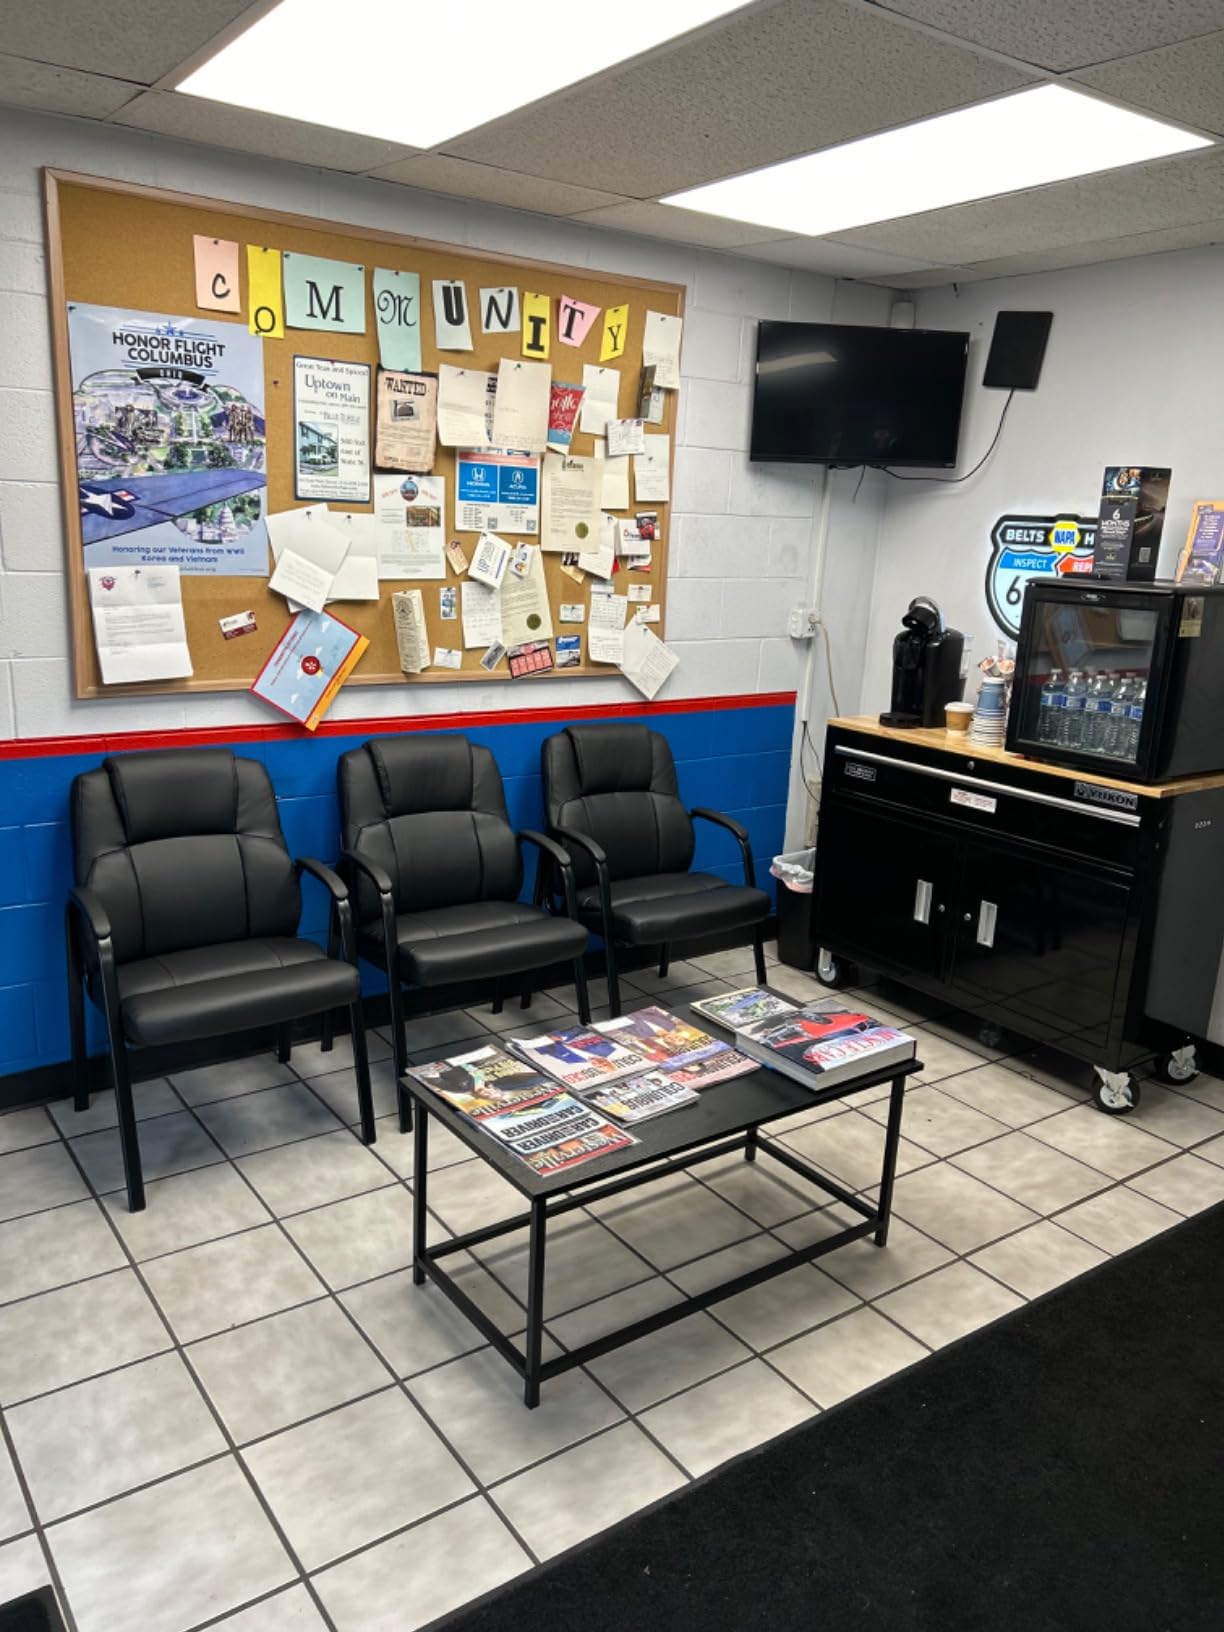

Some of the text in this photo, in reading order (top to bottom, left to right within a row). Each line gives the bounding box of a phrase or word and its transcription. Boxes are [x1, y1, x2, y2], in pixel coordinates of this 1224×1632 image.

[112, 331, 226, 357] HONOR FLIGHT
[128, 348, 213, 369] COLUMBUS
[305, 374, 351, 393] Uptown
[384, 377, 427, 396] WANTED
[325, 391, 361, 403] on Main
[1112, 508, 1121, 520] 6
[1006, 529, 1045, 543] BELTS
[1054, 530, 1076, 545] NAPA
[112, 546, 151, 555] Honoring
[169, 546, 204, 554] Veterans
[205, 547, 224, 555] from
[1014, 558, 1048, 570] INSPECT
[1089, 788, 1135, 807] YUKON
[622, 1081, 687, 1110] COLUMBUS
[500, 1104, 585, 1138] CAR DRIVER
[517, 1118, 601, 1151] CAR DRIVER
[533, 1134, 627, 1169] Westerville
